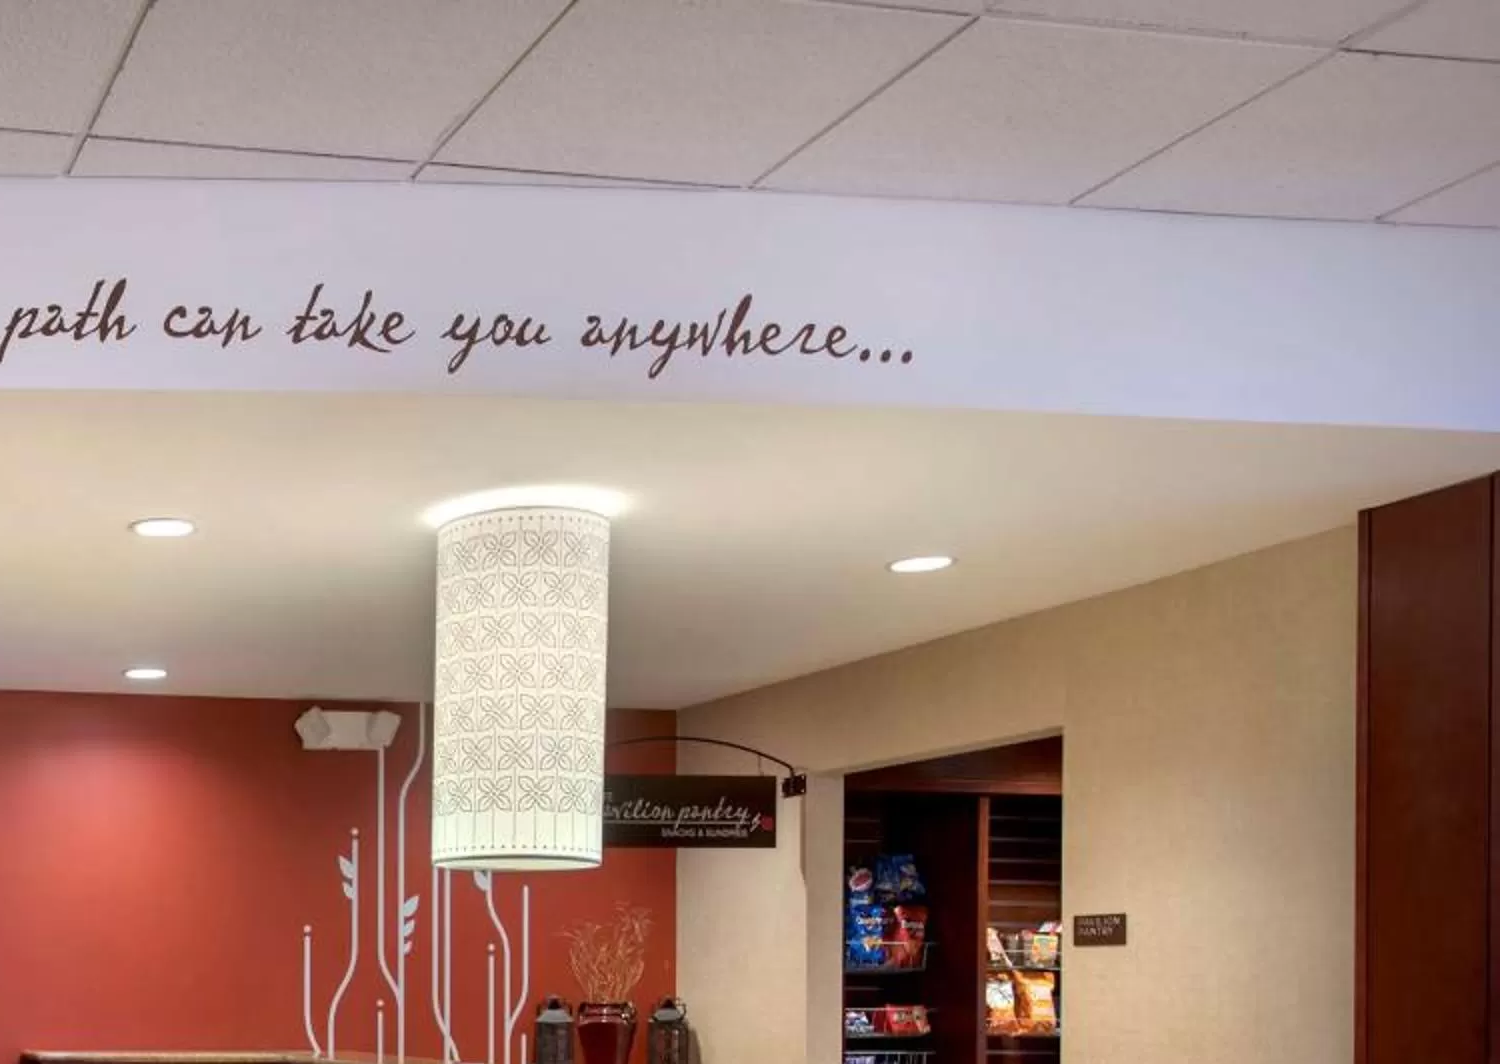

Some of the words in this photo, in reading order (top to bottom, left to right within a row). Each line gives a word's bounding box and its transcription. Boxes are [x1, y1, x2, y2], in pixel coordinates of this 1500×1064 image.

[163, 305, 263, 349] can
[285, 283, 416, 354] take
[439, 313, 552, 375] you
[580, 293, 913, 380] anywhere...
